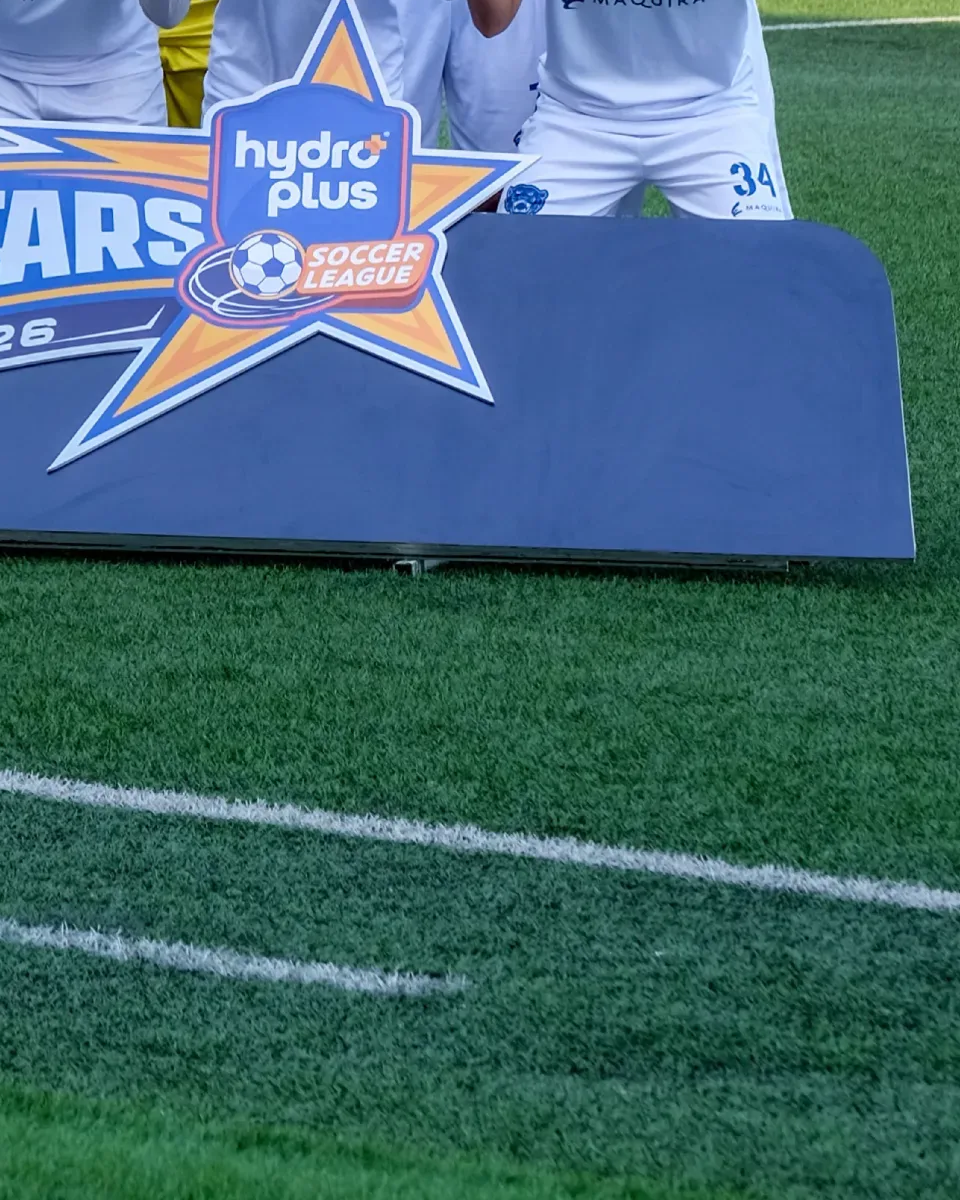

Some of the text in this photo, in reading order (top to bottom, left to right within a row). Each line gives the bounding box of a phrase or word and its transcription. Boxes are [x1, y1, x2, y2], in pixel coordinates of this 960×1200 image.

[234, 130, 383, 180] hydro
[267, 172, 378, 218] plus
[730, 162, 776, 198] 34
[308, 242, 425, 268] SOCCER
[303, 265, 414, 289] LEAGUE
